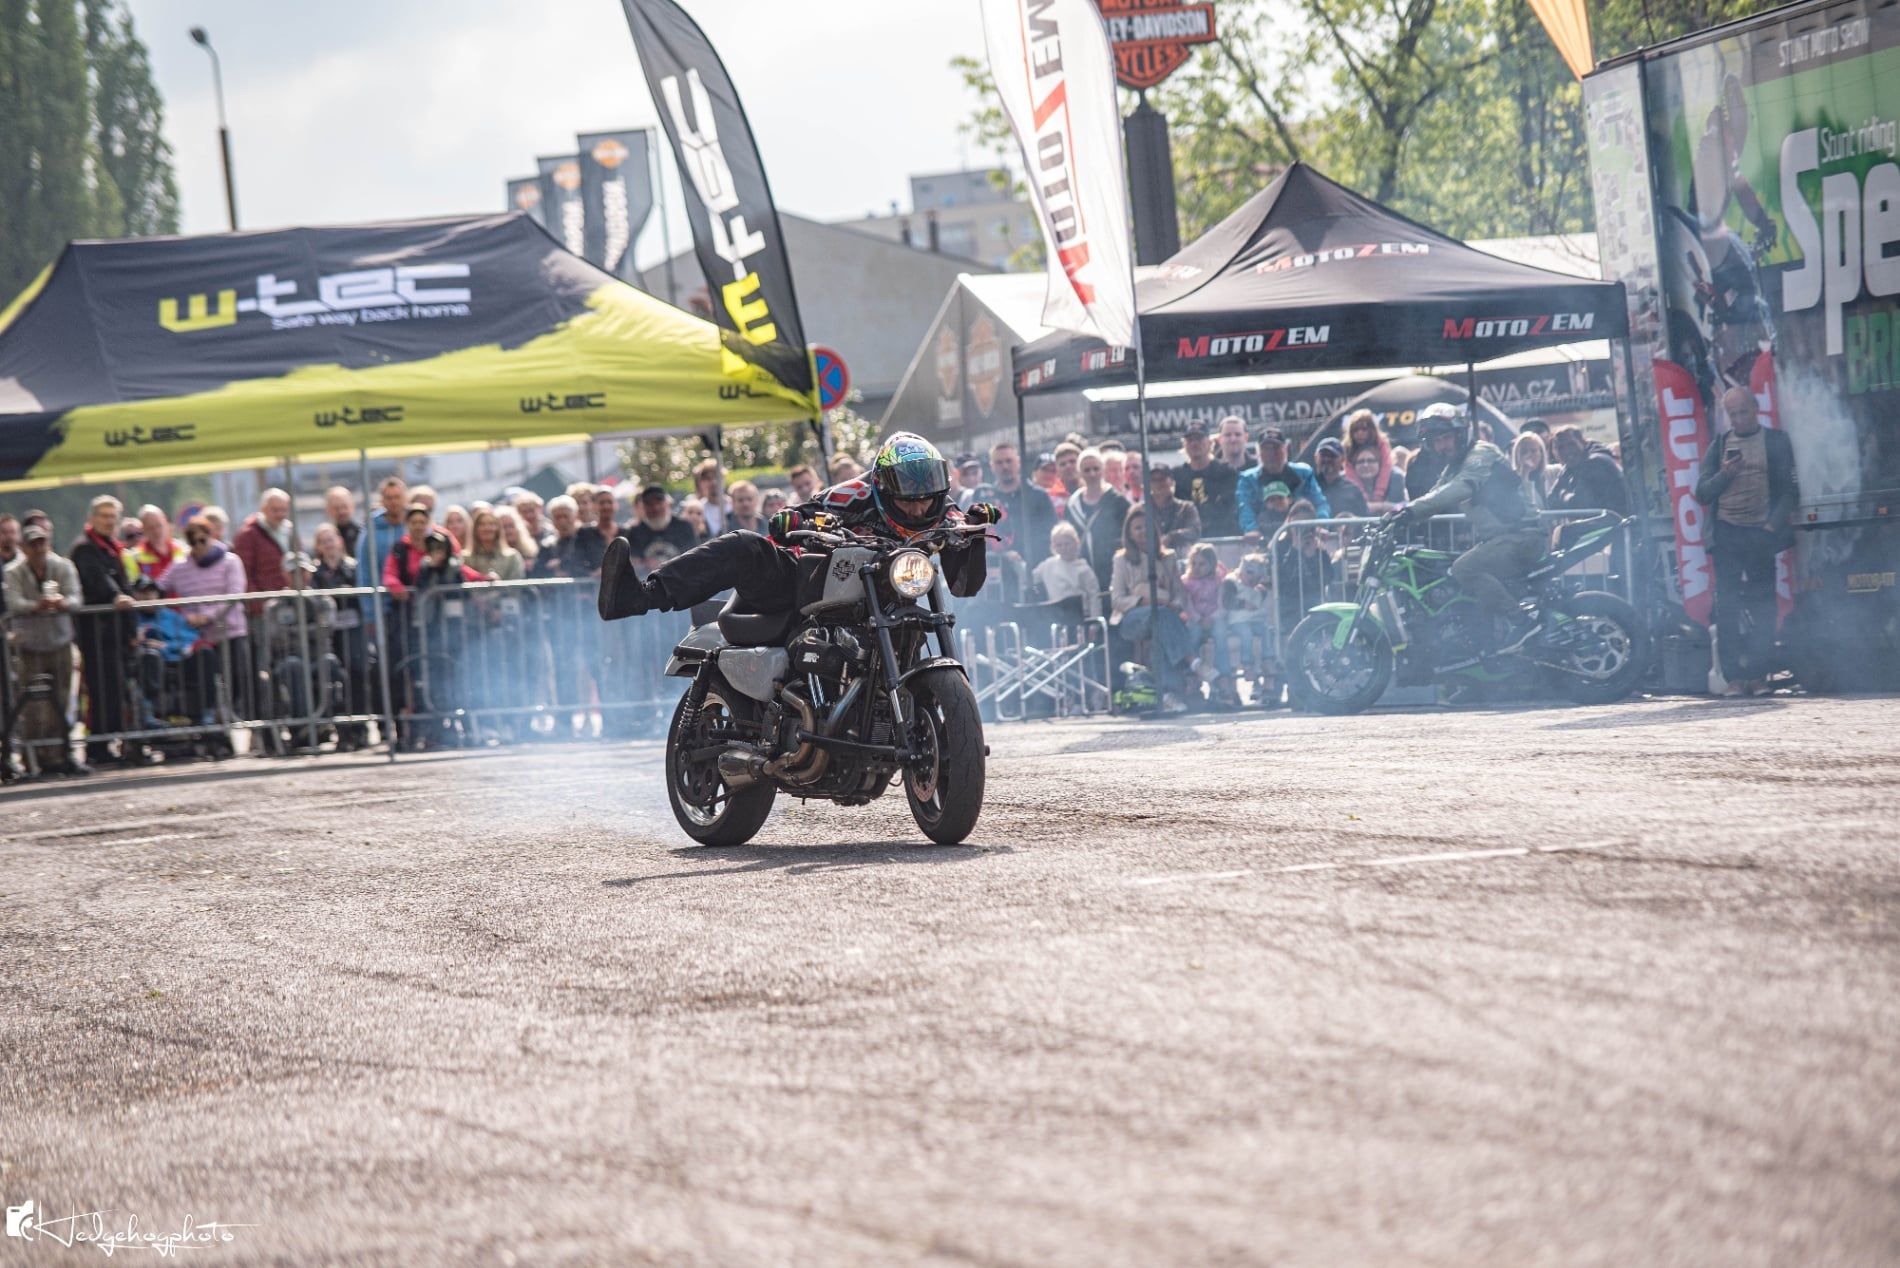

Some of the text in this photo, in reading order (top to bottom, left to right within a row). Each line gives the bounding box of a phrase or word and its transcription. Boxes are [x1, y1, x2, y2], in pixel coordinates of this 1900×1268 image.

[272, 315, 316, 330] Safe
[319, 312, 358, 326] way
[361, 307, 409, 323] back
